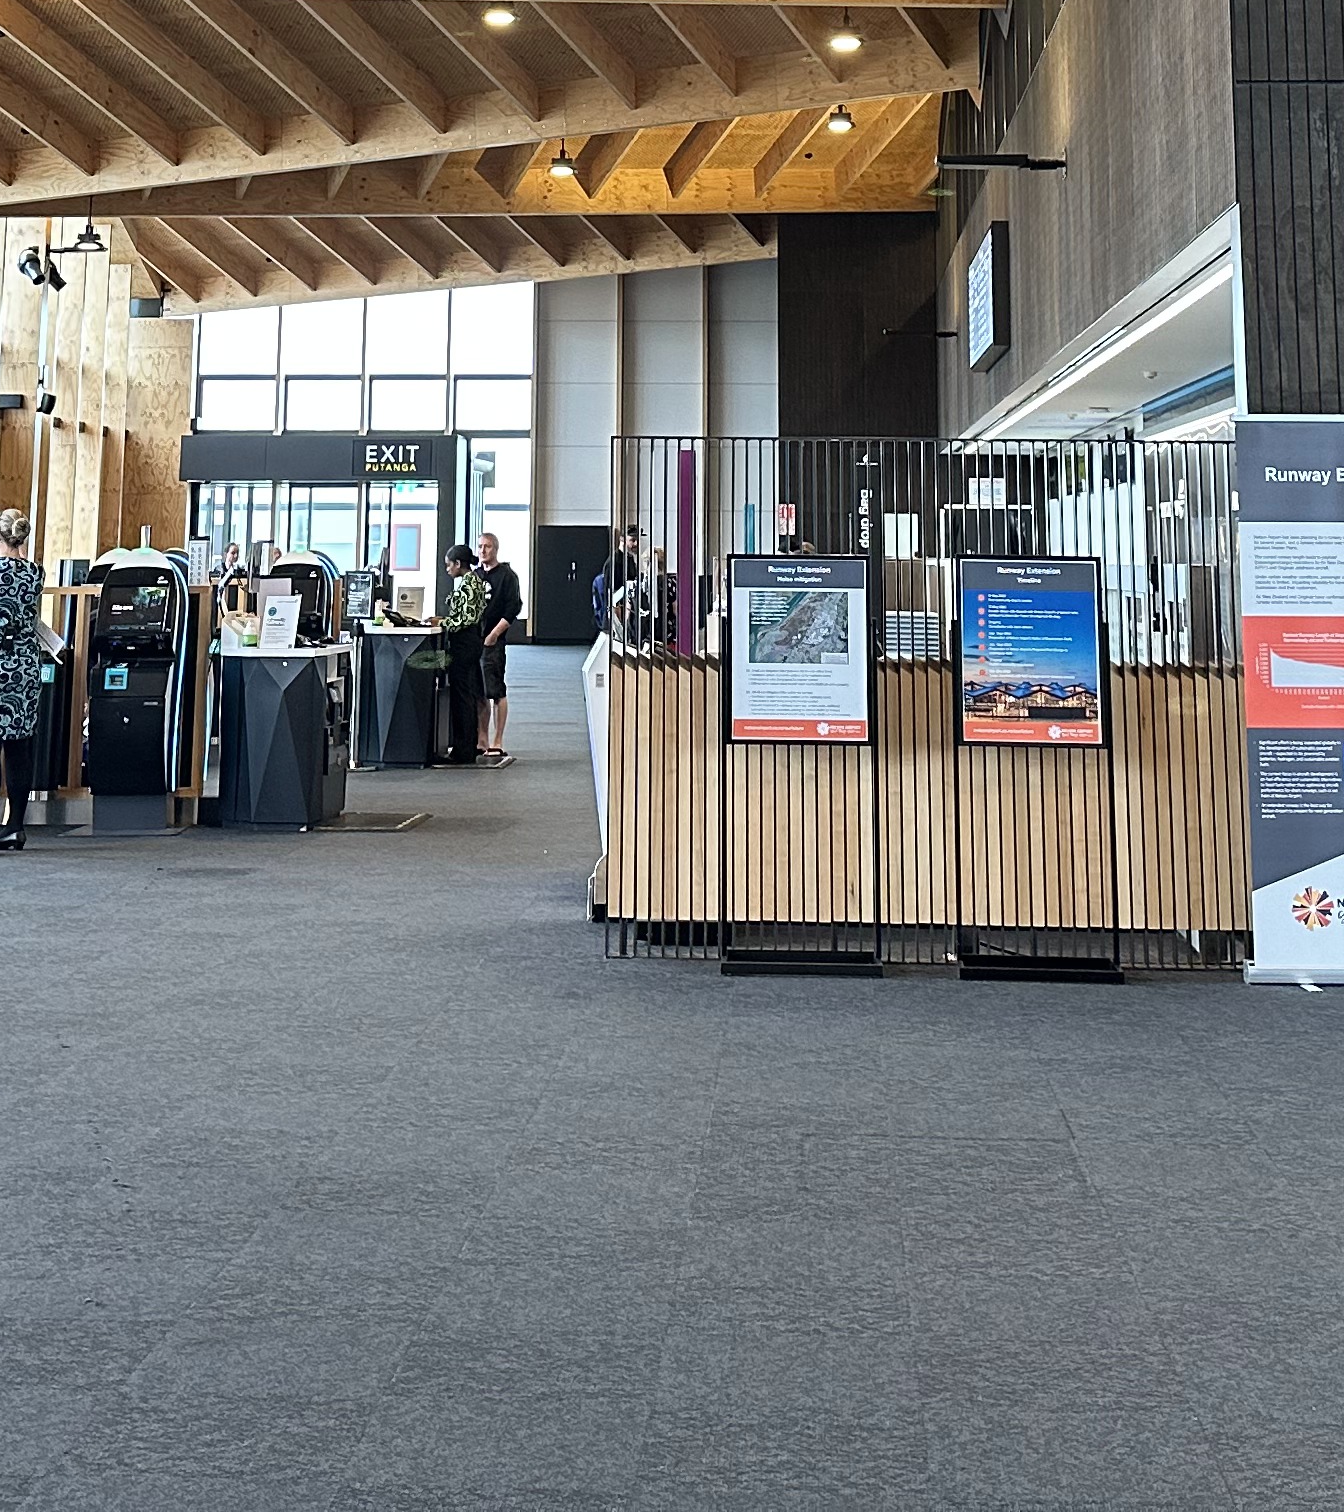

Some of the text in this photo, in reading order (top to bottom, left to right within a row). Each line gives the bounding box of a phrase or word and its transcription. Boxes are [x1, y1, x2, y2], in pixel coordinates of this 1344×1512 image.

[365, 444, 420, 463] EXIT
[365, 463, 417, 472] PUTANGA
[1264, 466, 1332, 486] Runway
[767, 565, 831, 575] Runway Extension
[997, 566, 1061, 575] Runway Extension
